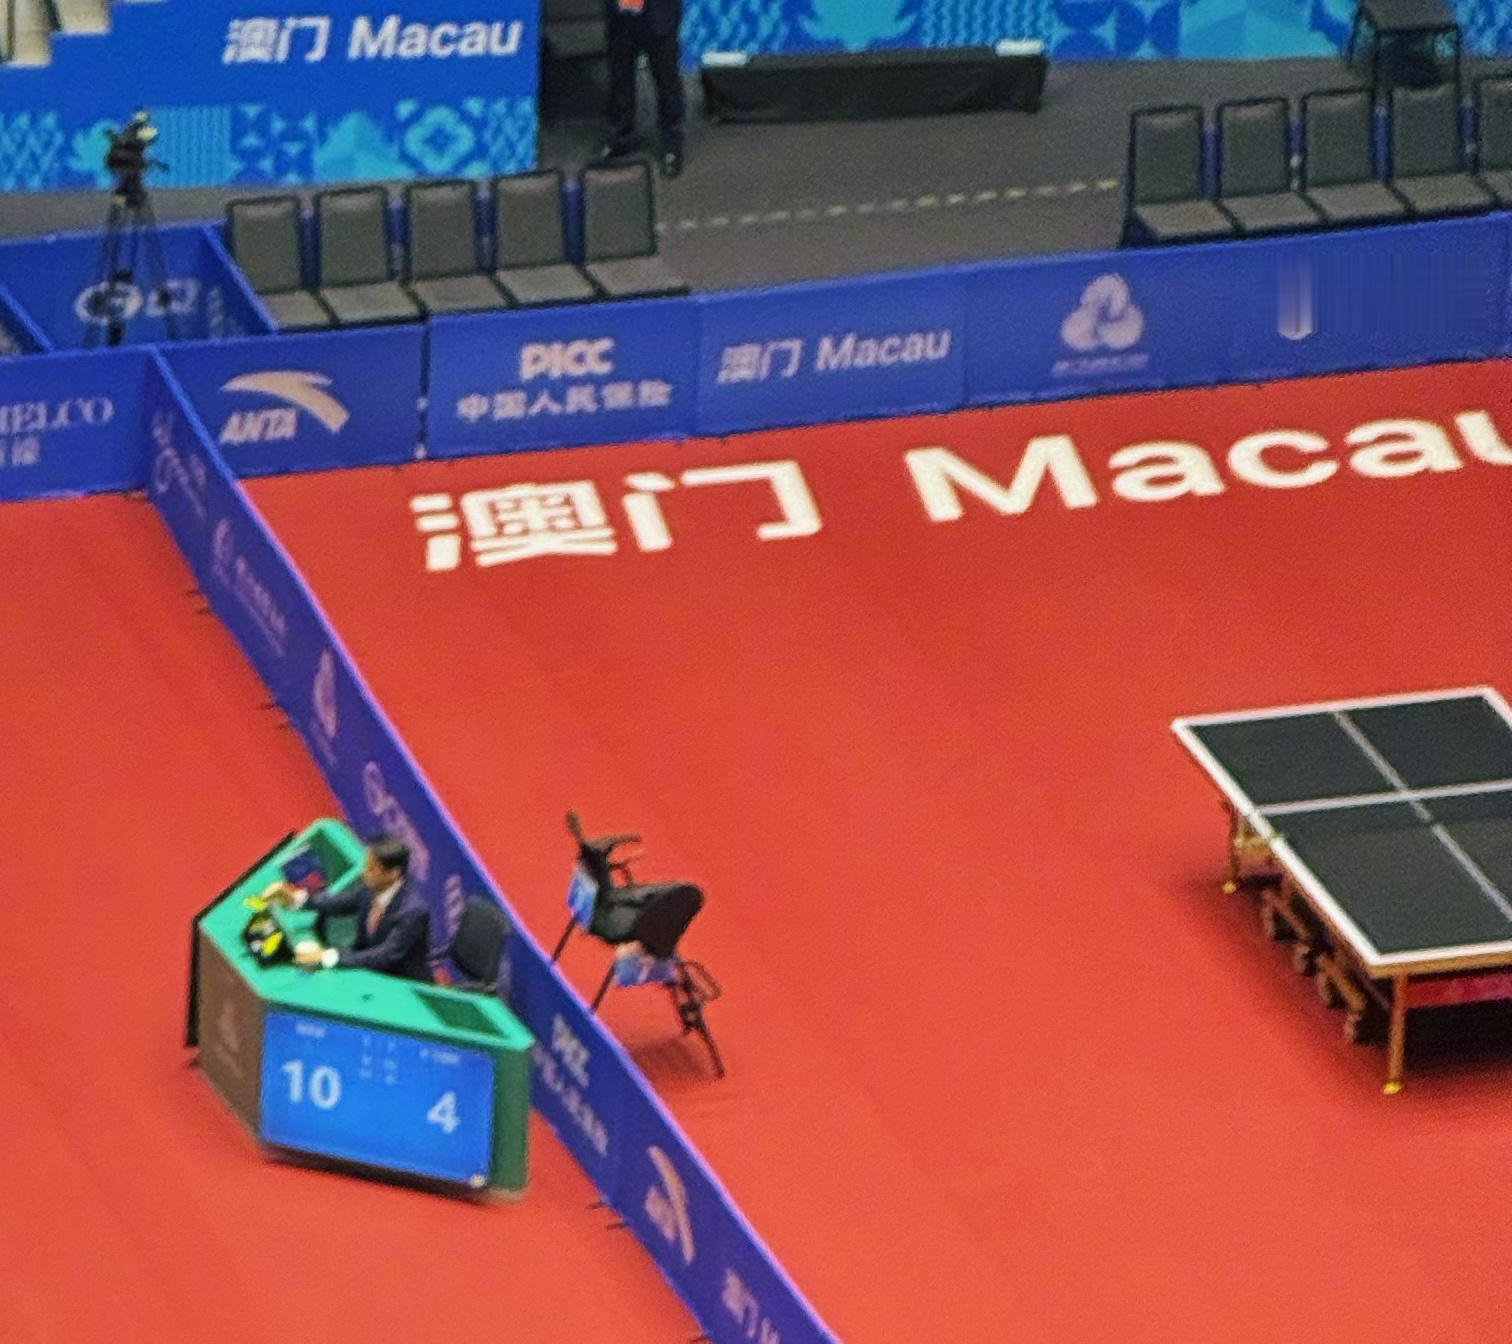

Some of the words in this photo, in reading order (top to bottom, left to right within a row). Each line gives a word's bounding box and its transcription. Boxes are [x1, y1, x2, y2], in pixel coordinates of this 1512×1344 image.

[221, 16, 331, 64] 澳门
[348, 14, 524, 59] Macau
[520, 337, 614, 380] PICC
[815, 330, 952, 372] Macau
[219, 408, 297, 445] ANTA
[409, 460, 822, 571] 澳门
[282, 1059, 342, 1110] 10
[426, 1091, 460, 1134] 4
